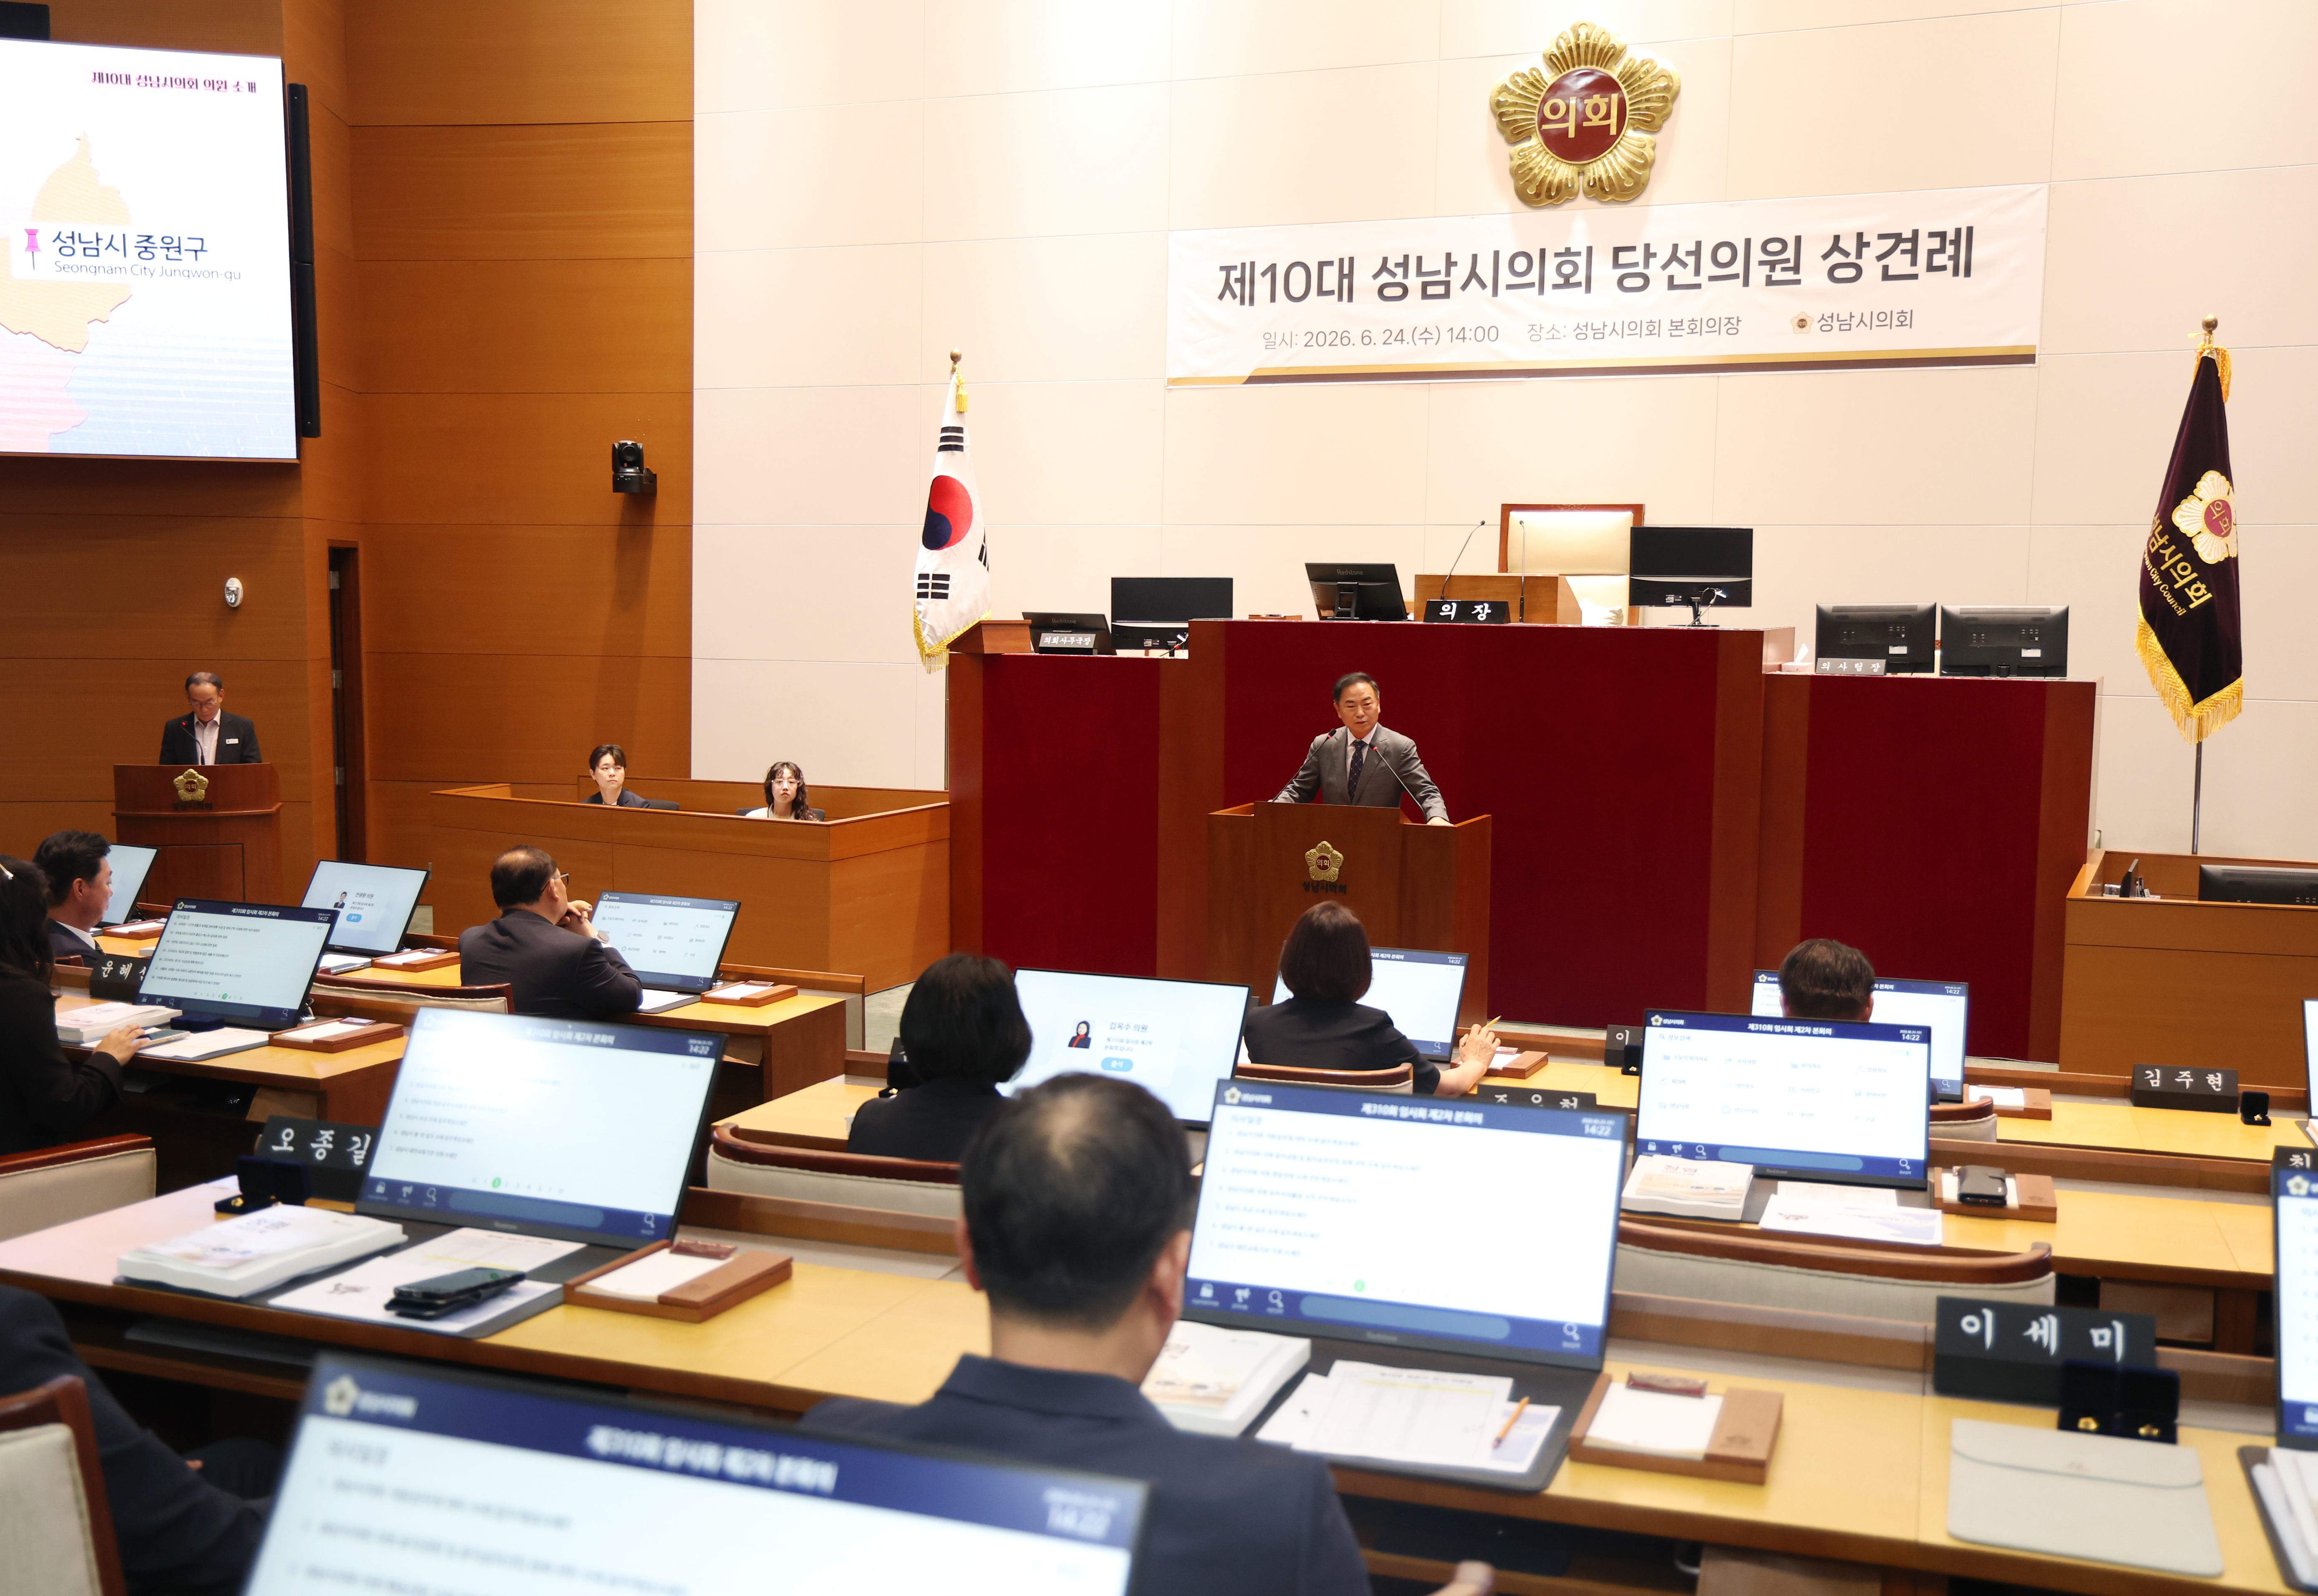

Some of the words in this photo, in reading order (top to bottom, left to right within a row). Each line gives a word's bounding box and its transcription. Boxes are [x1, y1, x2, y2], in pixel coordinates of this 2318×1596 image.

[91, 72, 132, 85] 제10대
[136, 74, 198, 89] 성남시의회
[203, 79, 228, 92] 의원
[1542, 93, 1619, 138] 의회
[52, 231, 127, 258] 성남시
[134, 234, 208, 261] 중원구
[55, 261, 127, 276] Seongnam
[130, 264, 155, 278] City
[159, 265, 241, 282] Jungwon-gu
[1217, 256, 1354, 307] 제10대
[1372, 246, 1593, 302] 성남시의회
[1611, 235, 1802, 293] 당선의원
[1821, 226, 1974, 284] 상견례
[1527, 322, 1566, 343] 장소:
[1572, 317, 1661, 341] 성남시의회
[1668, 315, 1742, 338] 본회의장
[1818, 310, 1913, 332] 성남시의회
[1262, 330, 1298, 350] 일시:
[1304, 328, 1355, 348] 2026.
[1361, 328, 1377, 347] 6.
[1382, 325, 1441, 346] 24.(수)
[1447, 325, 1499, 344] 14:00
[2209, 501, 2231, 536] 의회
[2150, 568, 2162, 586] City
[2159, 584, 2187, 616] Council
[1043, 636, 1091, 646] 의회사무국장
[1316, 859, 1329, 868] 의회
[1302, 882, 1347, 895] 성남시의회
[1109, 1022, 1131, 1031] 김옥수
[1133, 1024, 1148, 1033] 의원
[1747, 1023, 1773, 1032] 제310회
[1774, 1025, 1793, 1033] 임시회
[1794, 1026, 1812, 1035] 제2차
[1813, 1027, 1832, 1036] 본회의
[689, 1045, 710, 1055] 14:22
[2145, 1068, 2223, 1091] 김주현
[1362, 1102, 1398, 1118] 제310회
[1399, 1104, 1428, 1120] 임시회
[1428, 1107, 1453, 1122] 제2차
[1584, 1124, 1612, 1137] 14:22
[272, 1128, 371, 1166] 오종길
[1960, 1308, 2125, 1362] 이세미
